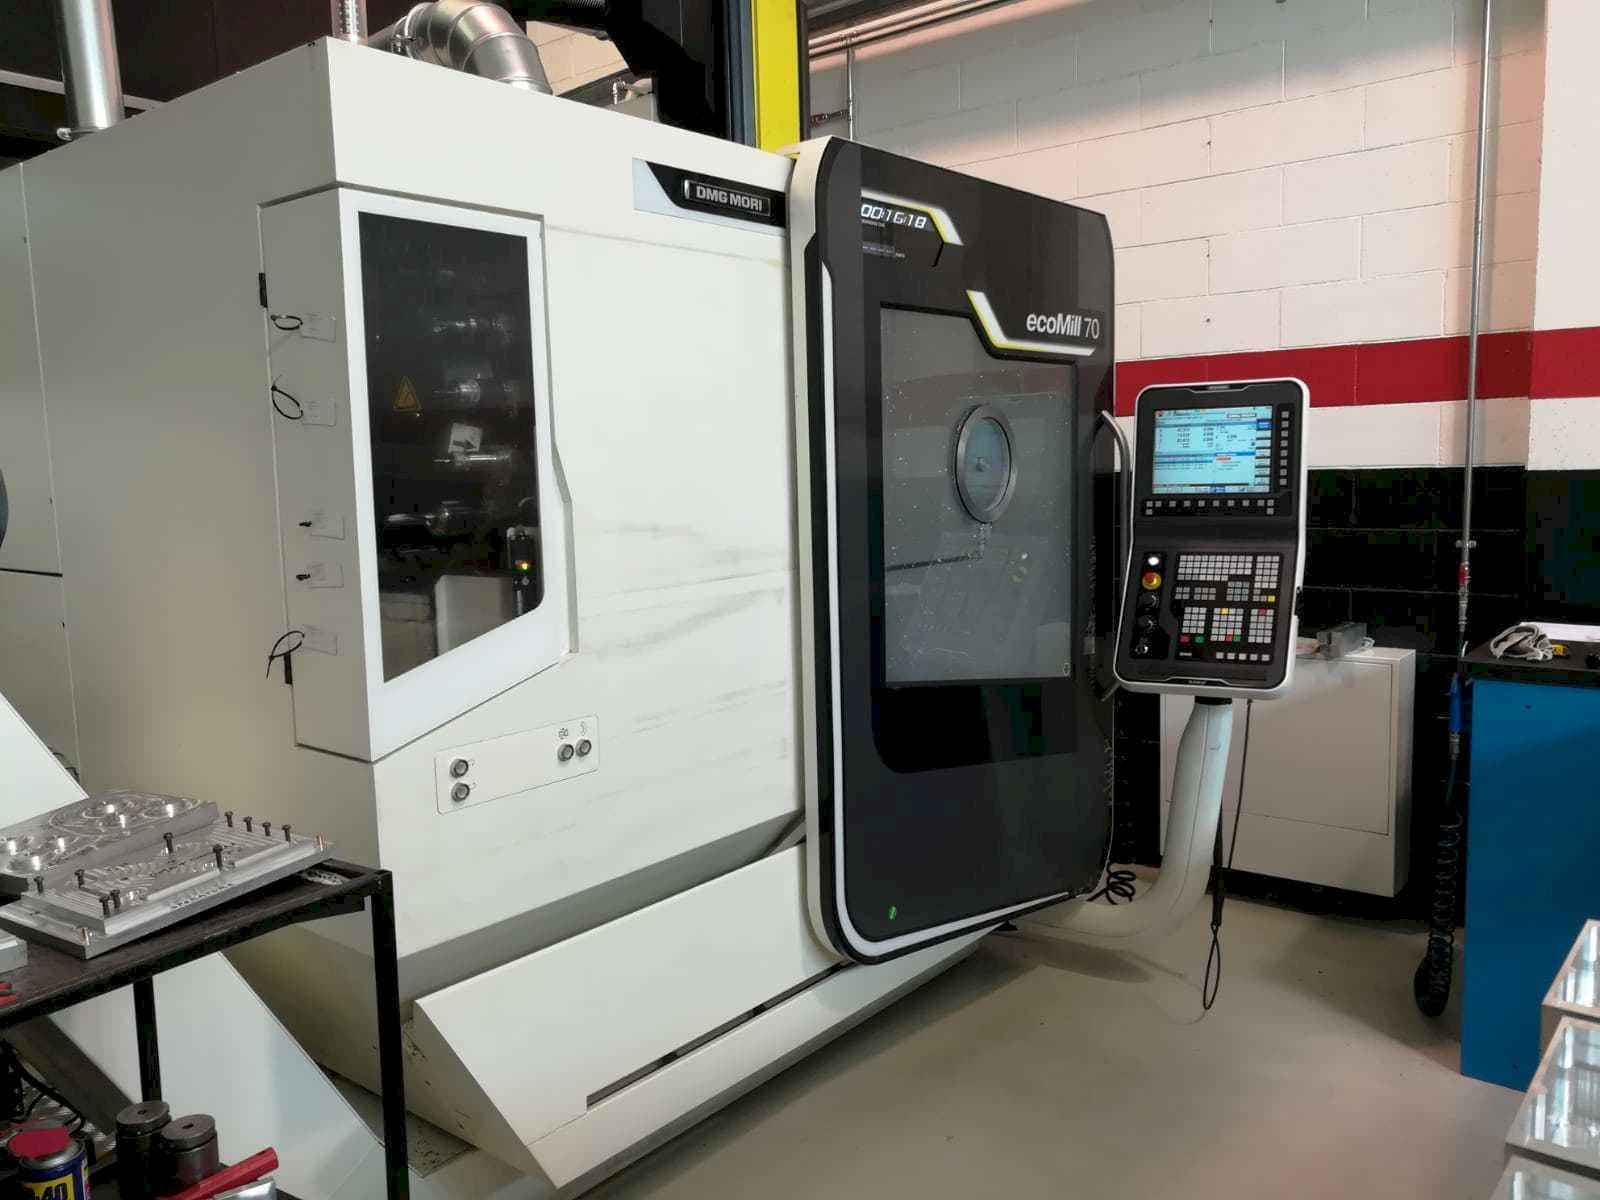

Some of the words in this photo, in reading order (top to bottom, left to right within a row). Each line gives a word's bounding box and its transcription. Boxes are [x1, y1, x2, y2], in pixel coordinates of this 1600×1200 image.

[696, 186, 728, 203] DMG
[729, 193, 763, 211] MORI
[861, 204, 927, 229] 00:16:18
[1026, 313, 1082, 337] ecoMill
[1083, 317, 1100, 339] 70
